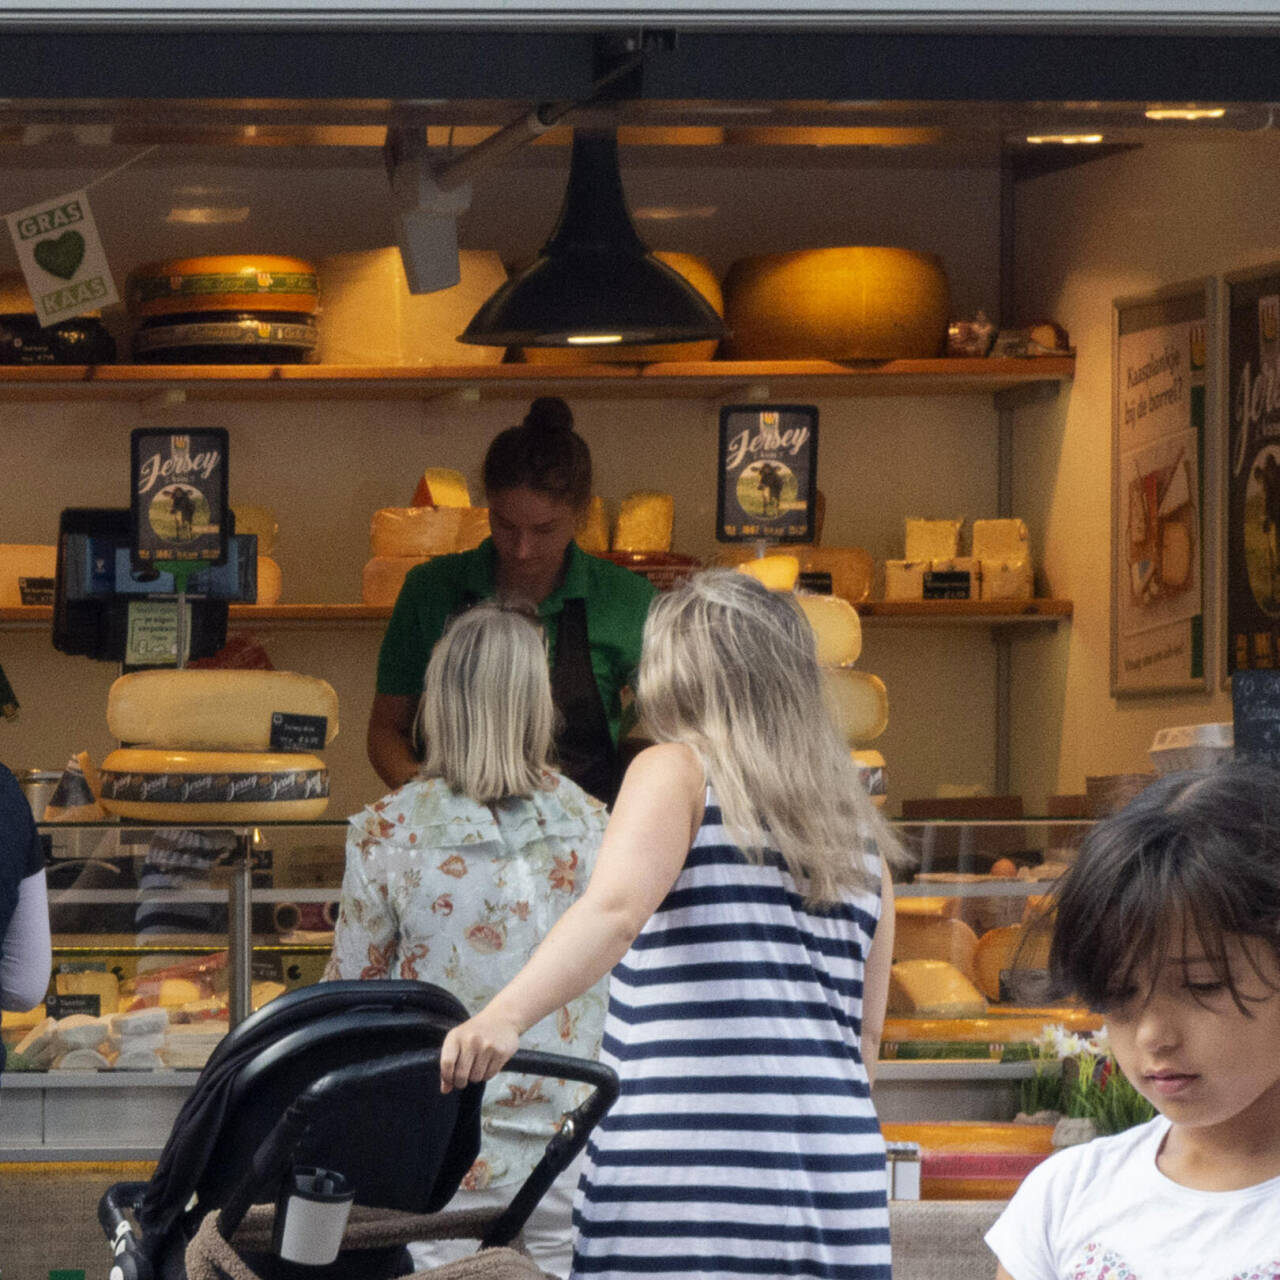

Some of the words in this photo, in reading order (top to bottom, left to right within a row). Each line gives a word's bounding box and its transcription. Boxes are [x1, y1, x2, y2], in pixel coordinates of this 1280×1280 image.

[18, 201, 83, 240] GRAS
[42, 277, 108, 316] KAAS
[726, 426, 811, 471] Jersey
[138, 450, 222, 494] Jersey
